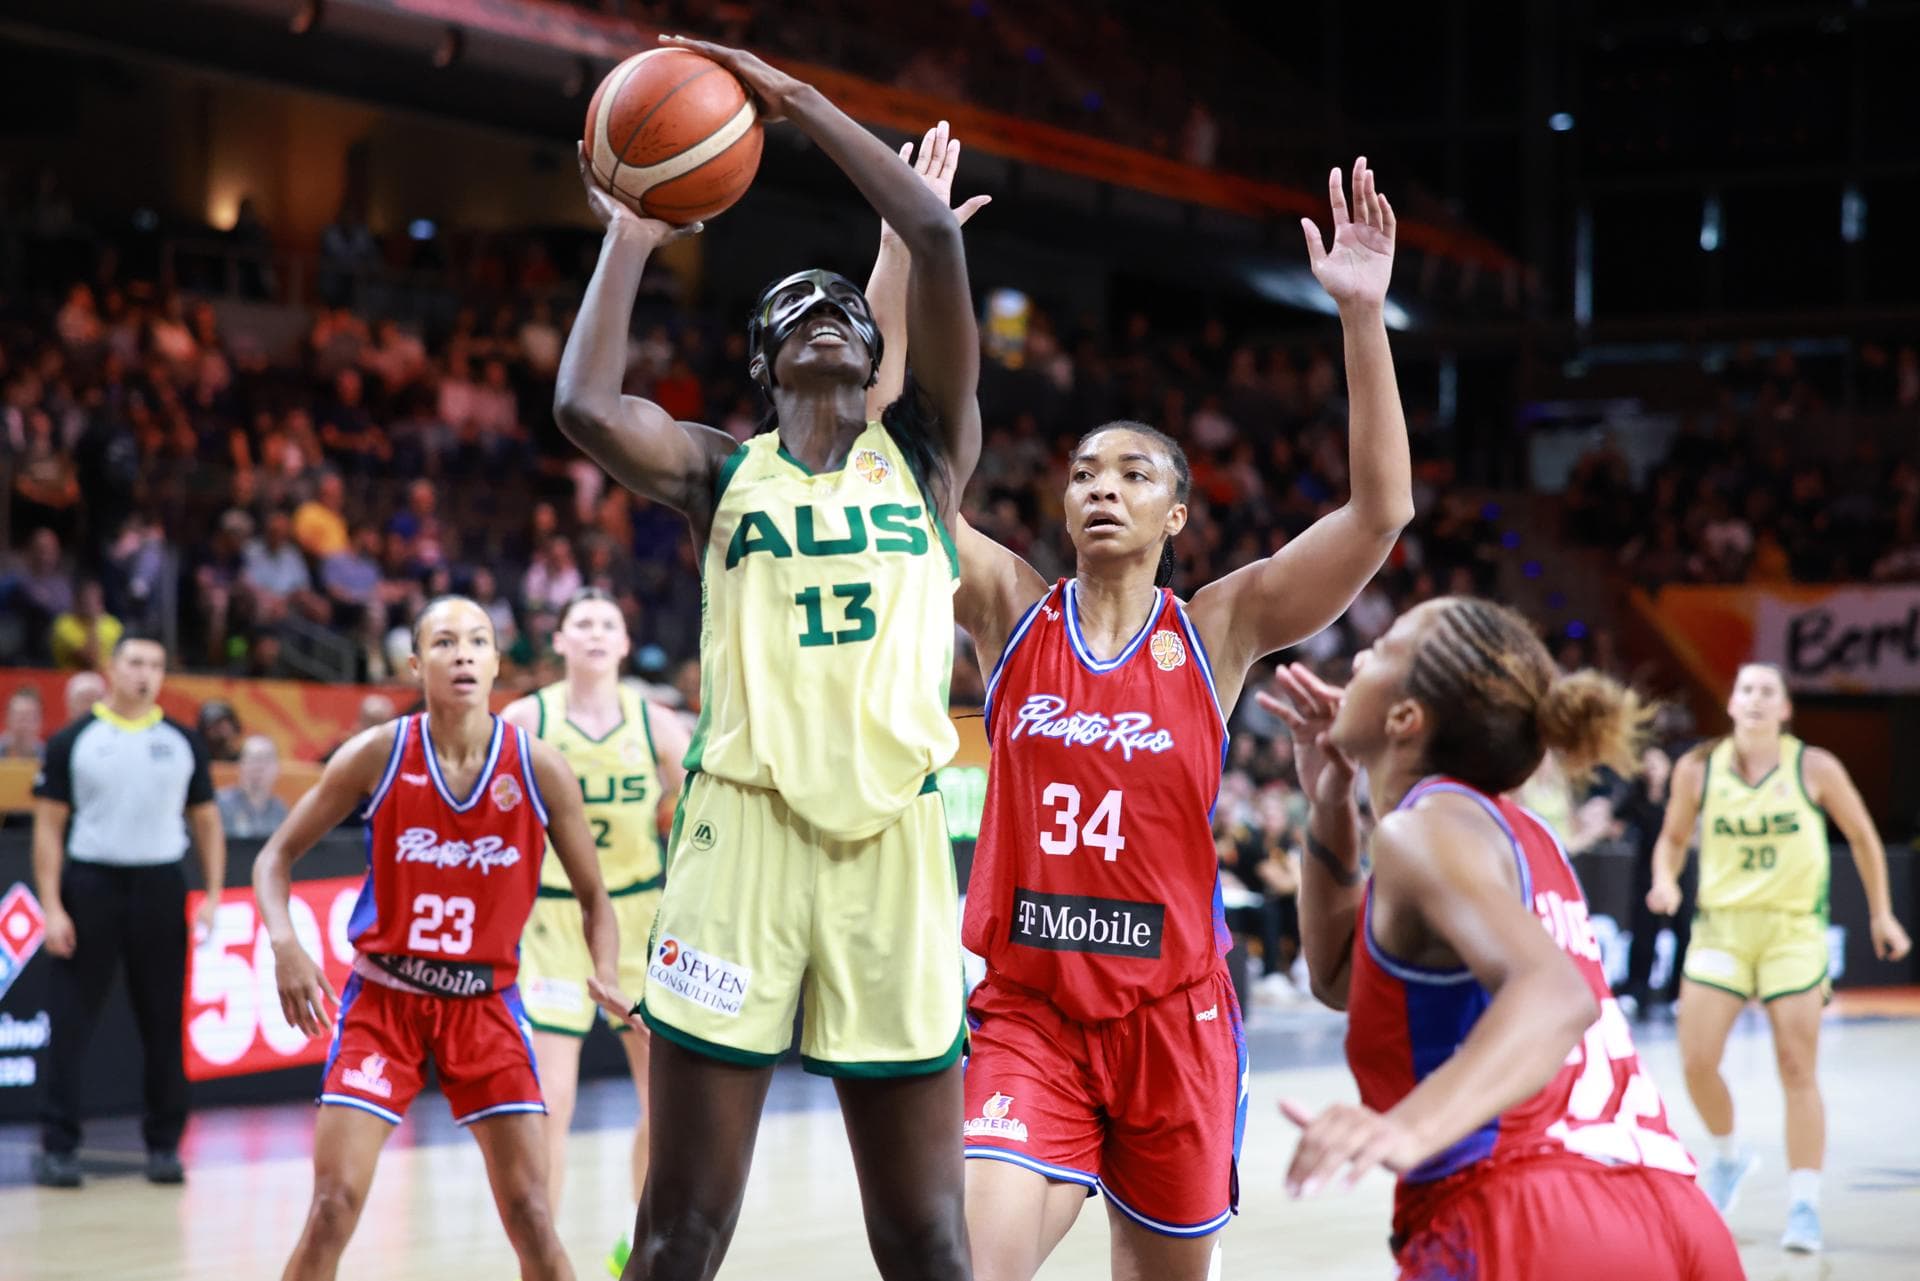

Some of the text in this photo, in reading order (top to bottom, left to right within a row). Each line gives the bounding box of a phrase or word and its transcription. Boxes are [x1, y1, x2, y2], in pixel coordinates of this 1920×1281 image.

[725, 503, 928, 571] AUS
[795, 582, 876, 647] 13
[1011, 694, 1174, 762] Puerto Rico
[578, 774, 646, 803] US
[1039, 782, 1126, 862] 34
[1714, 812, 1799, 837] AUS
[1740, 845, 1776, 870] 20
[408, 893, 475, 955] 23
[1040, 904, 1151, 947] Mobile
[398, 955, 487, 996] Mobile
[649, 964, 738, 1013] CONSULTING
[677, 950, 747, 995] SEVEN
